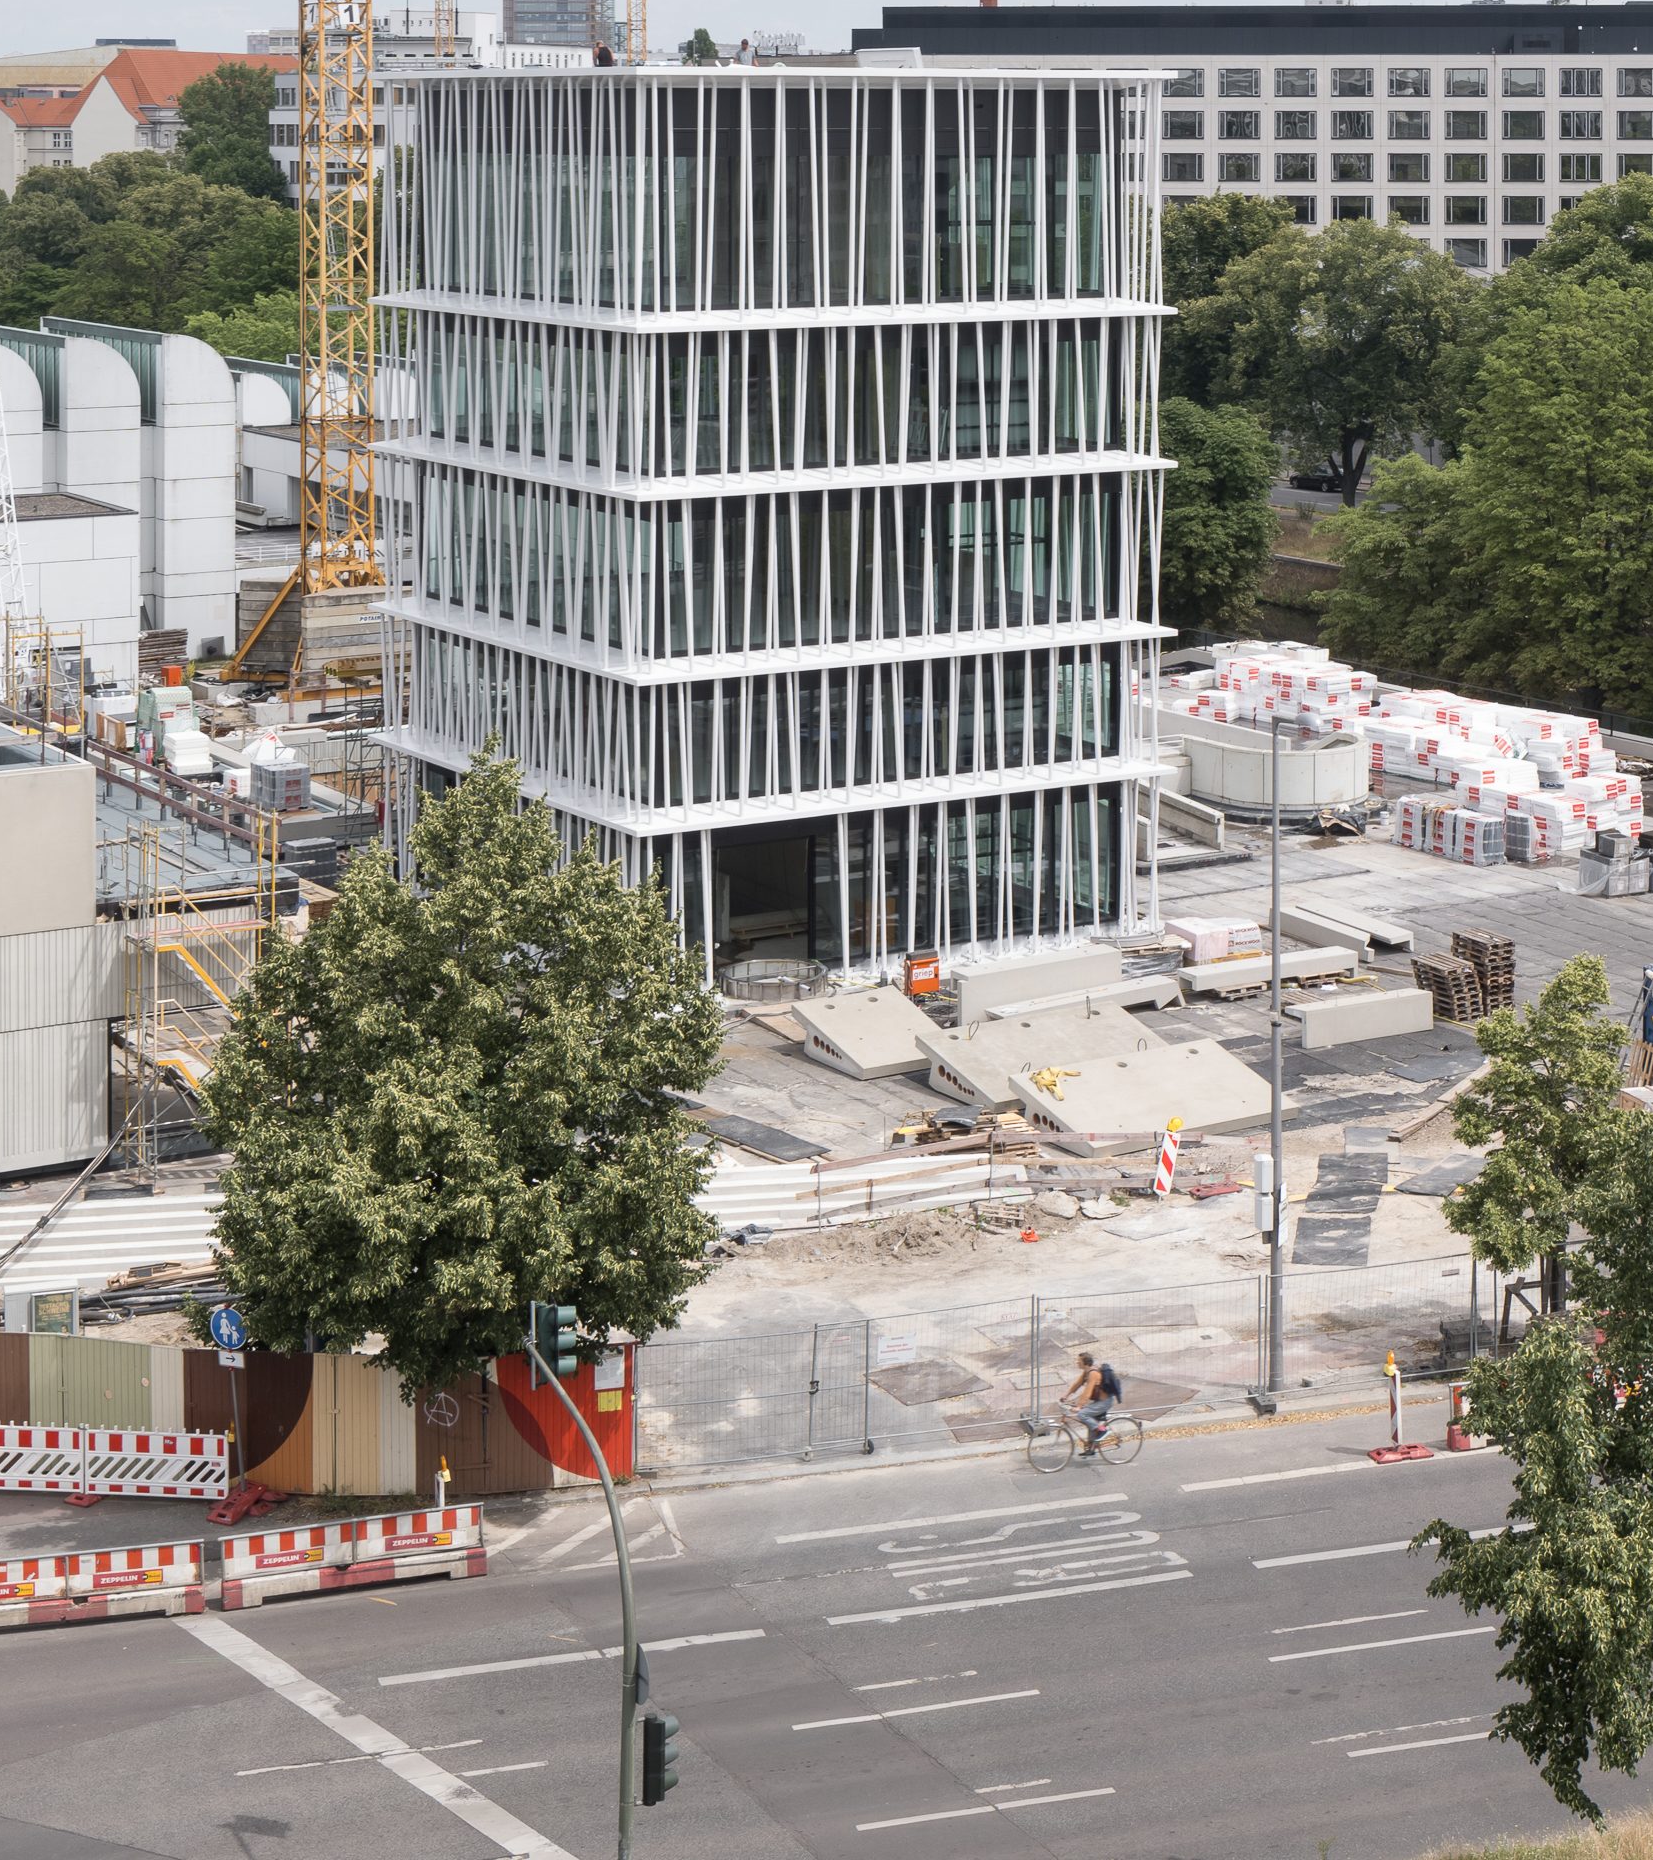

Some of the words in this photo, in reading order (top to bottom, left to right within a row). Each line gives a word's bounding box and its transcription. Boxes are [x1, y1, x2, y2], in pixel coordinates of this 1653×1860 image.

[344, 5, 354, 23] 1
[392, 1537, 428, 1547] ZEPPELIN
[262, 1553, 300, 1565] ZEPPELIN
[100, 1574, 138, 1585] ZEPPELIN
